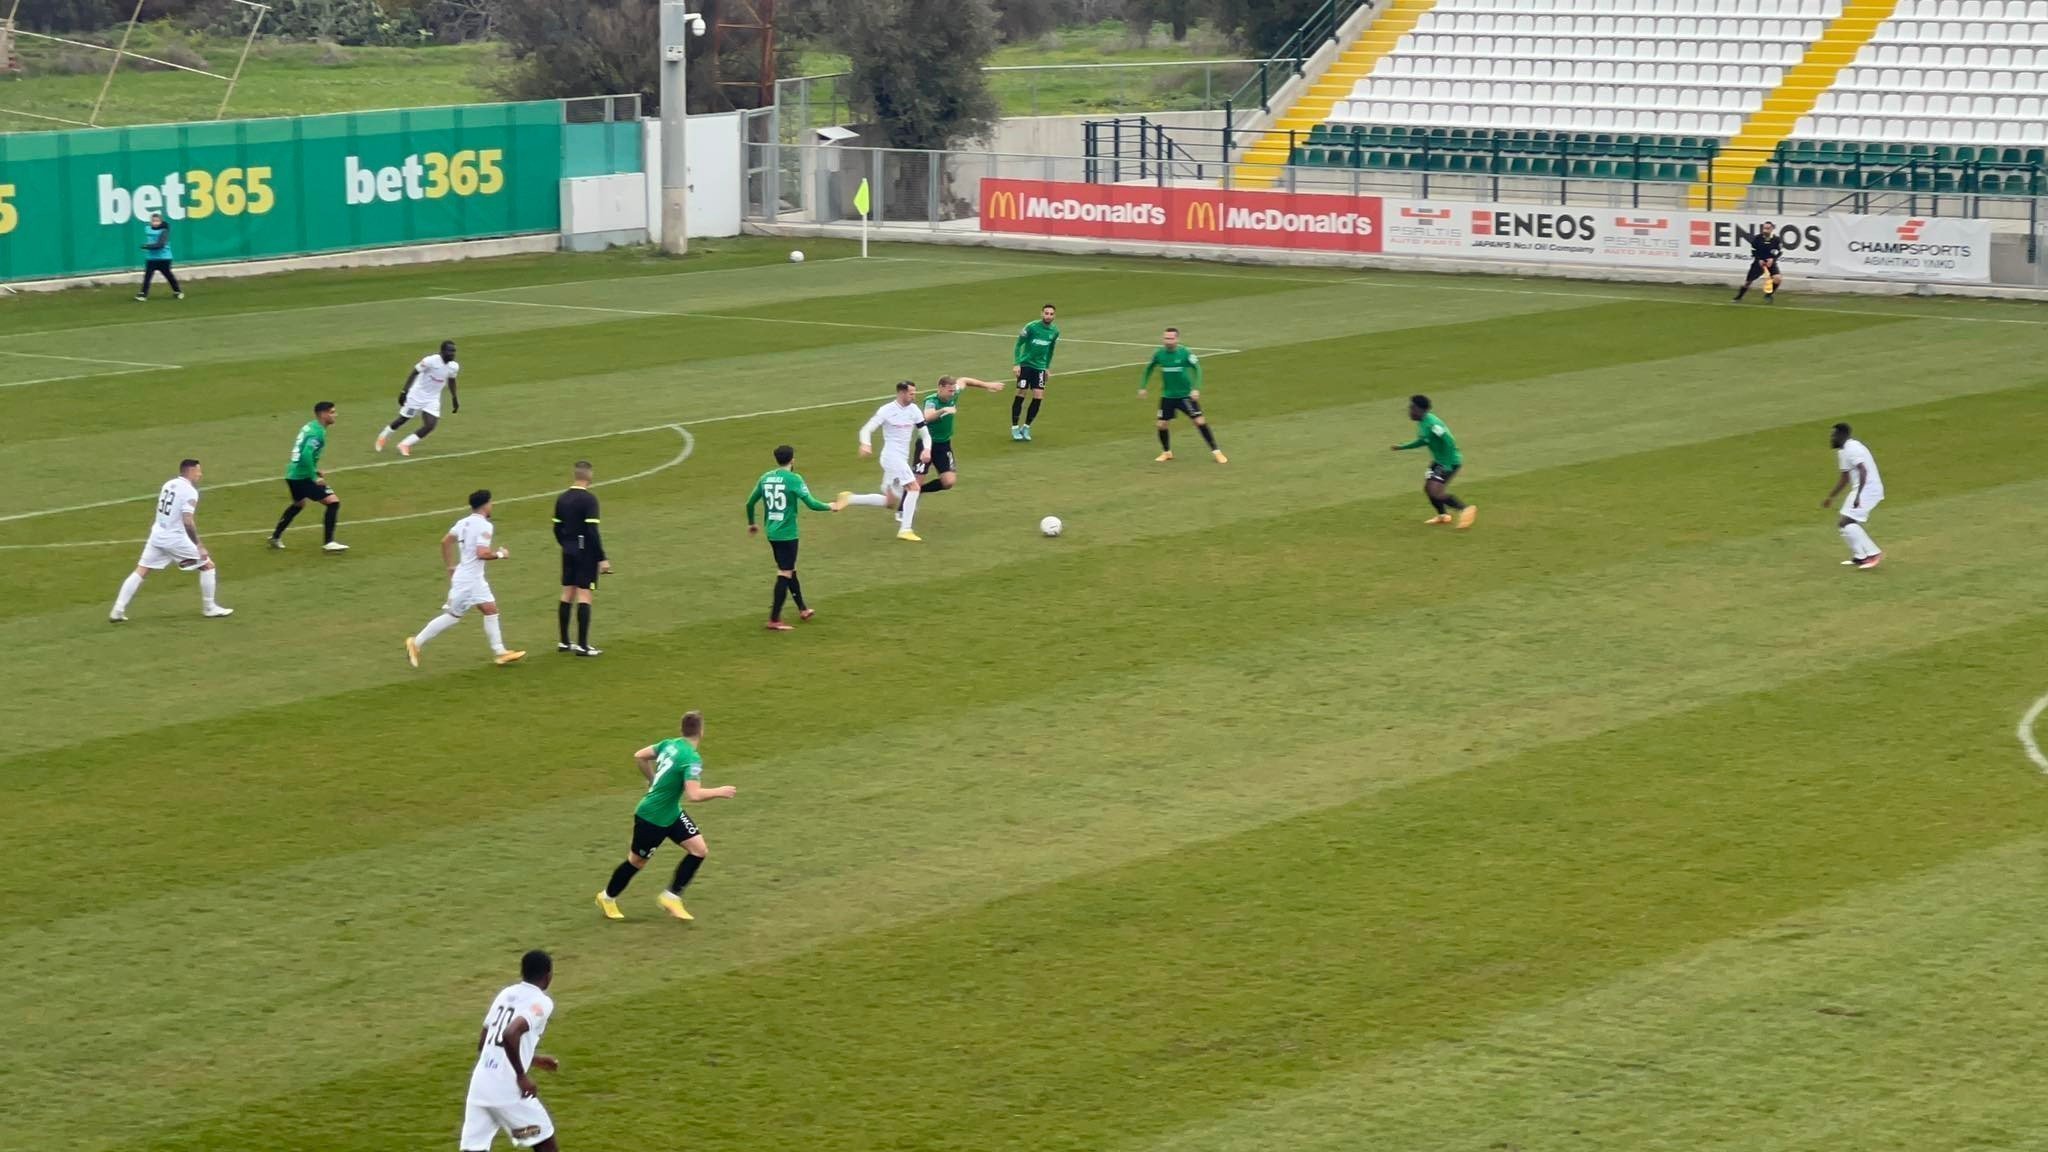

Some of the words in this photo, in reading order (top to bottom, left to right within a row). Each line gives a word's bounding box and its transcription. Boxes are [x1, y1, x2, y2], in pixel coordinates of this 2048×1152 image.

[345, 149, 504, 205] bet365
[97, 166, 275, 225] bet365
[1026, 197, 1167, 225] McDonald's
[1226, 207, 1373, 235] McDonald's
[1495, 211, 1596, 241] ENEOS
[1714, 221, 1822, 252] ENOS
[1847, 240, 1972, 257] CHAMPSPORTS
[158, 489, 176, 516] 32
[763, 484, 787, 511] 55
